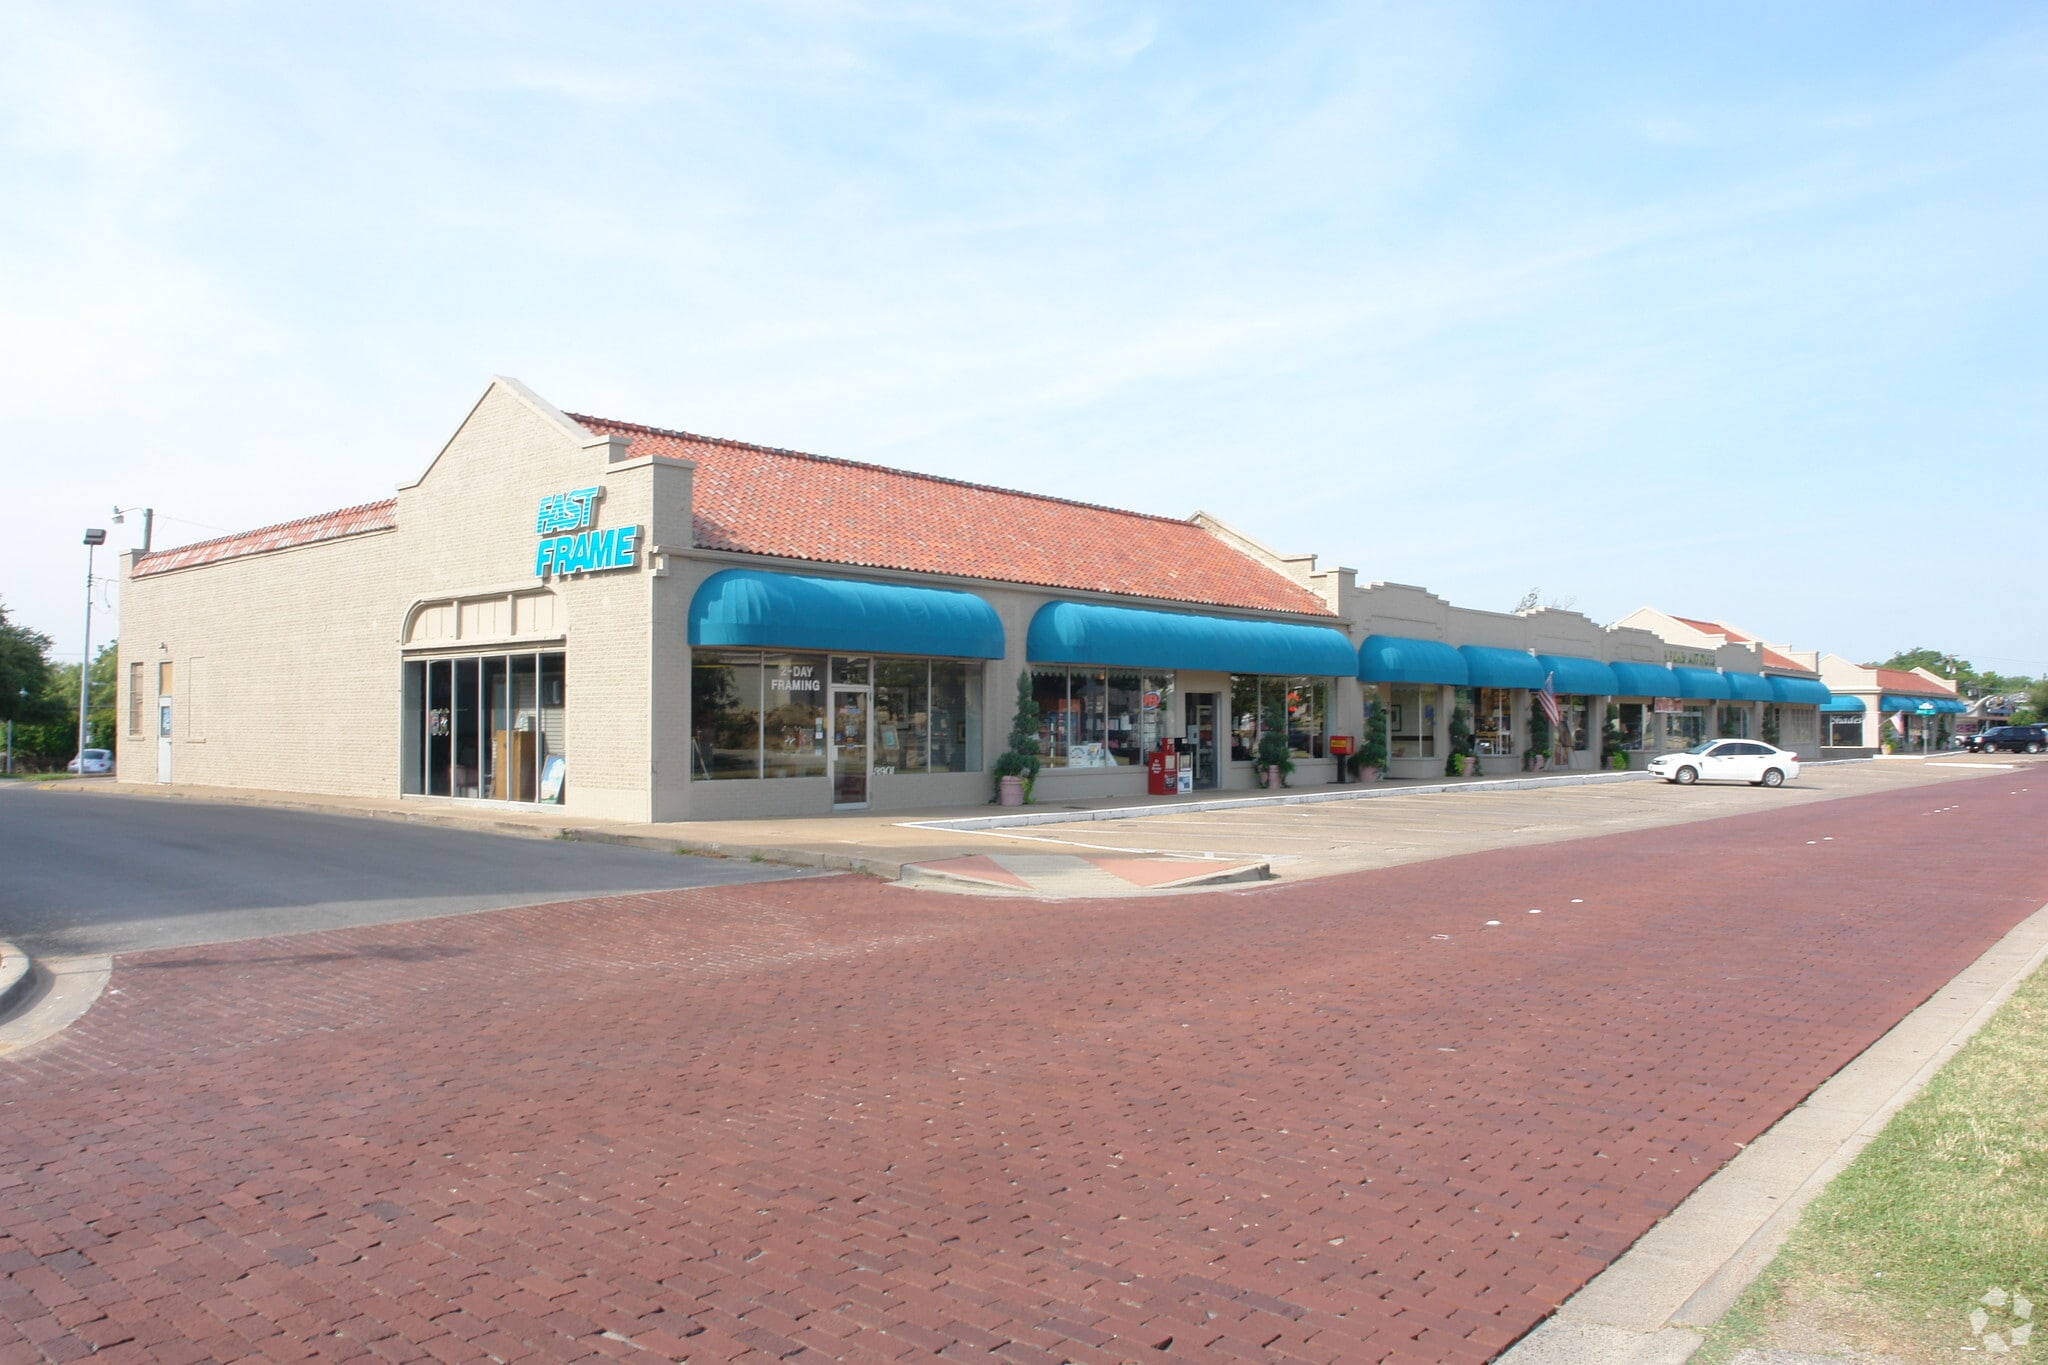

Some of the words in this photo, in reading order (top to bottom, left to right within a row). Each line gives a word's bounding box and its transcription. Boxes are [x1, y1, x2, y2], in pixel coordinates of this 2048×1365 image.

[536, 485, 602, 535] FAST
[534, 524, 640, 577] FRAME
[771, 679, 820, 691] FRAMING
[780, 665, 814, 678] 2-DAY
